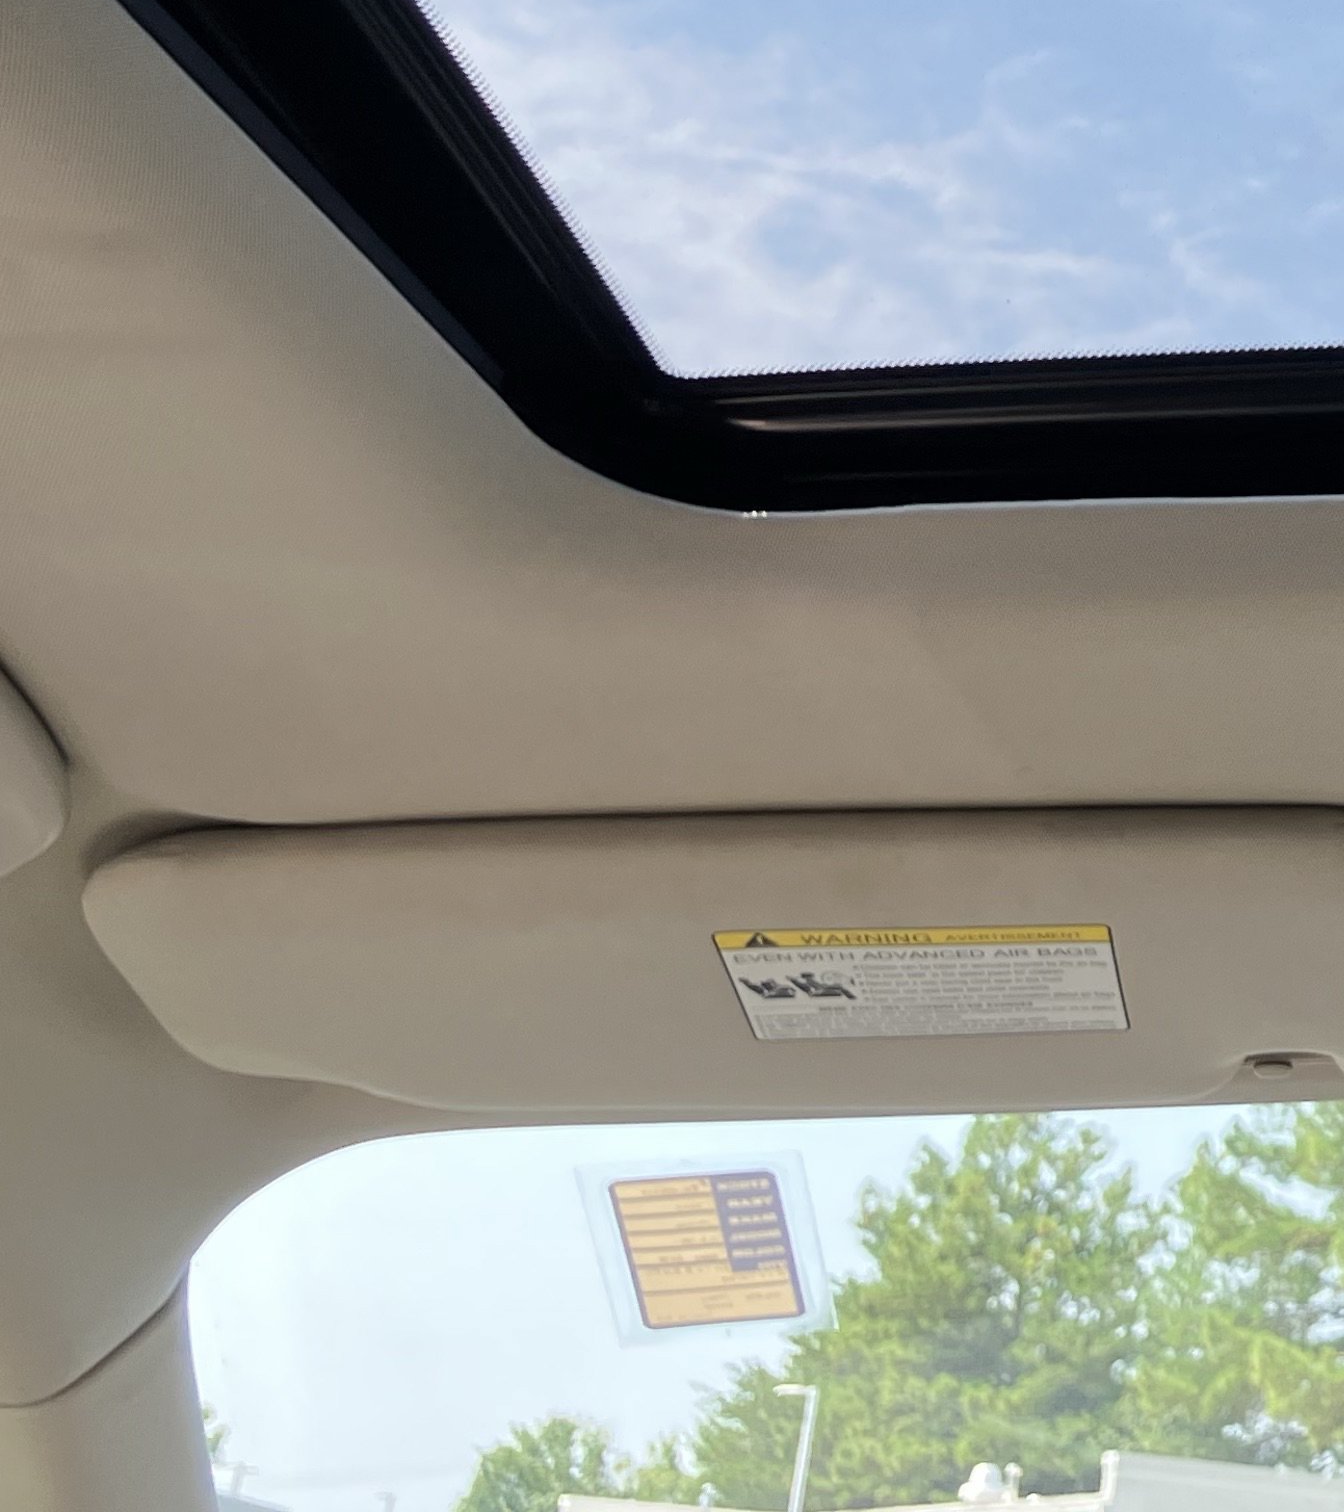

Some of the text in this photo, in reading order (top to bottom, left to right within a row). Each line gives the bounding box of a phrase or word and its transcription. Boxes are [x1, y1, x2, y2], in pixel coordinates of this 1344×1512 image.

[800, 933, 932, 945] WARNING
[733, 946, 1098, 964] EVEN WITH ADVANCED AIR BAGS
